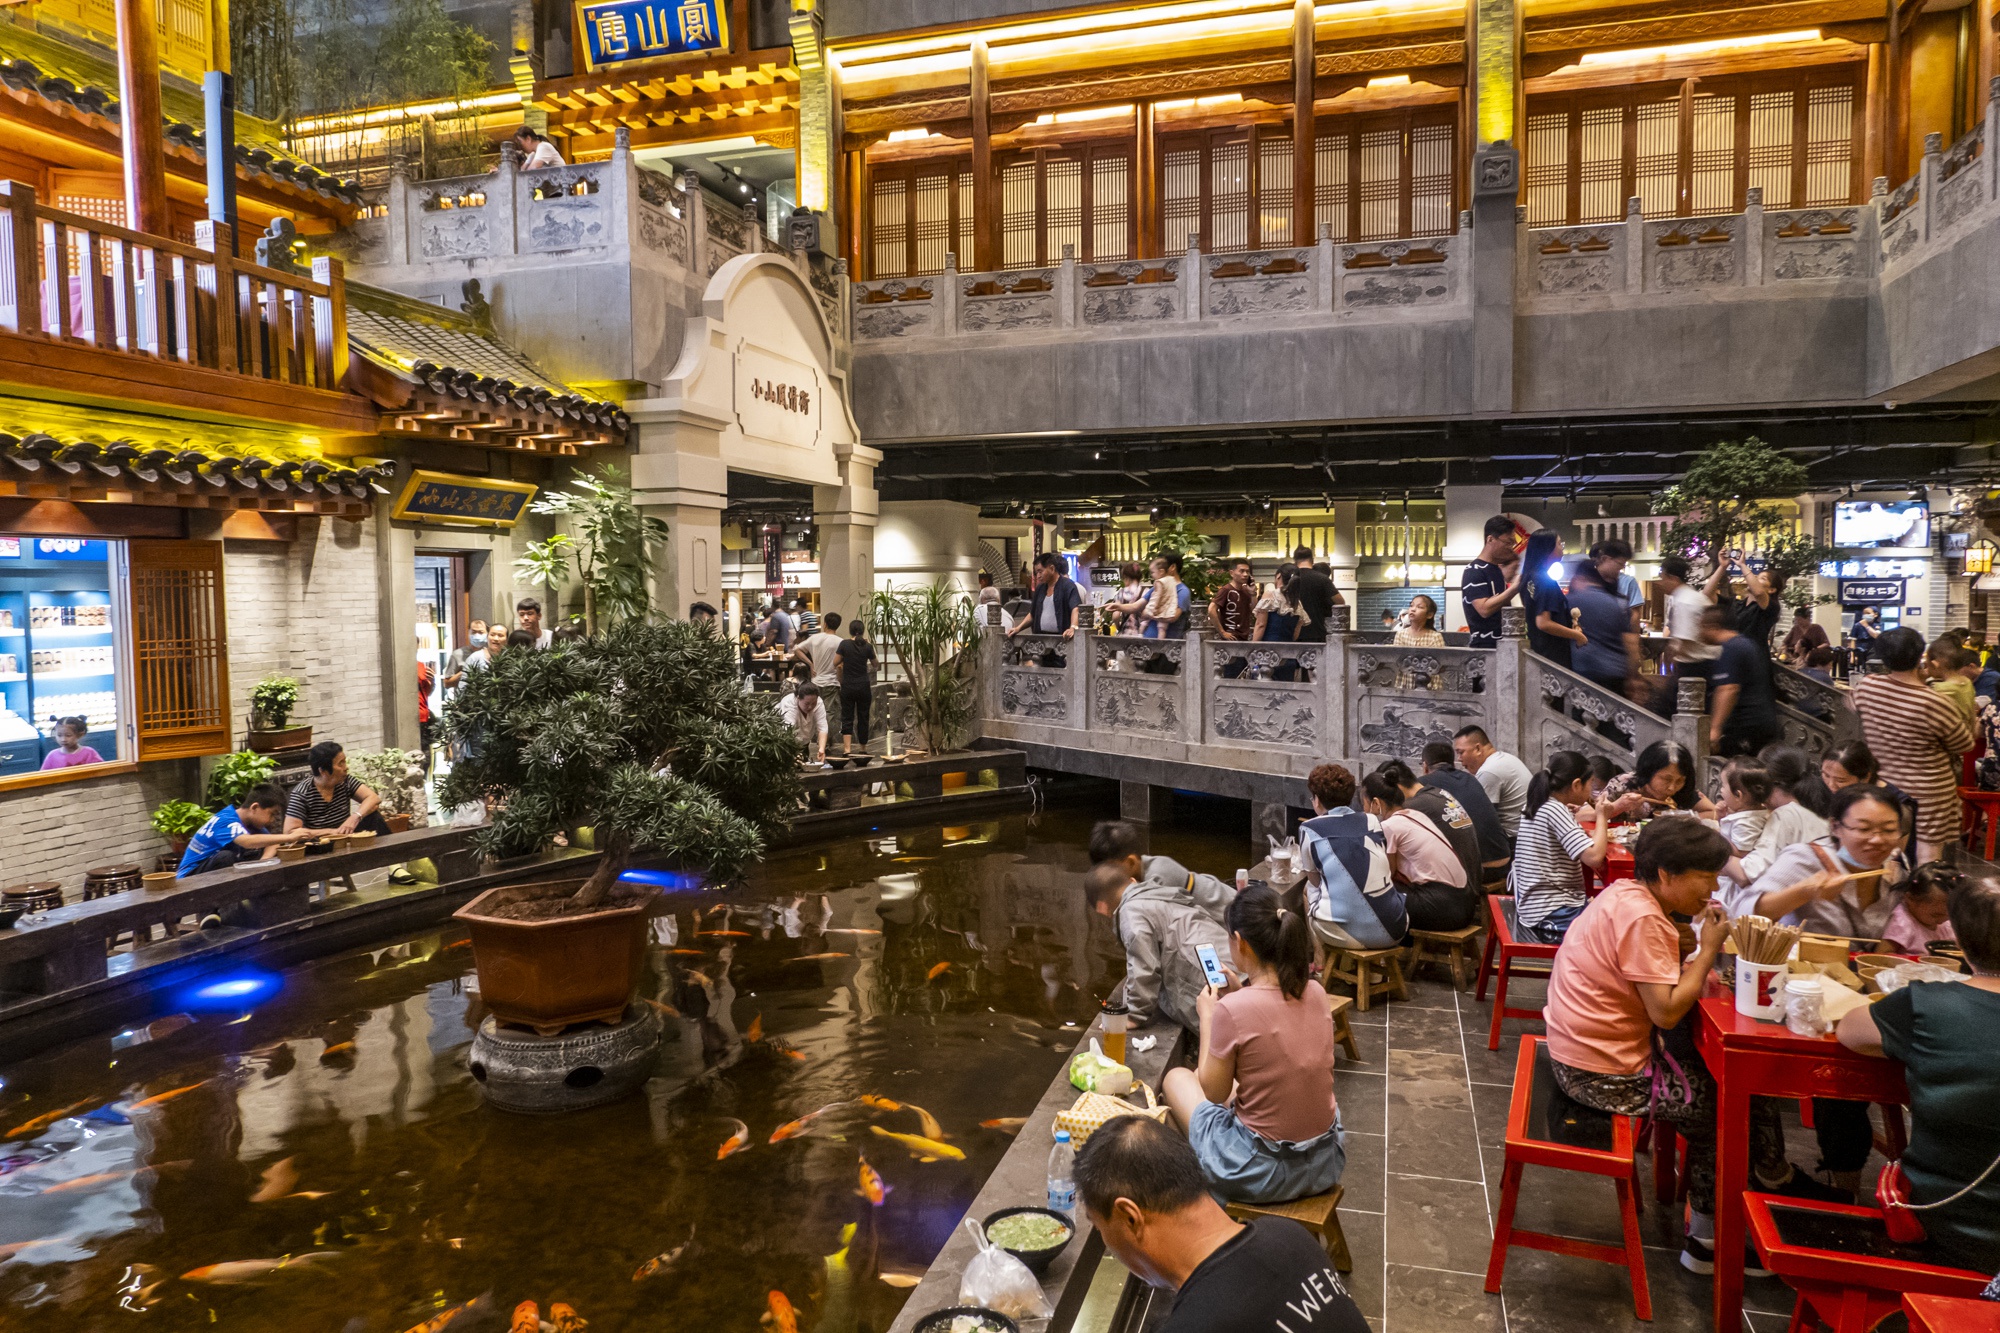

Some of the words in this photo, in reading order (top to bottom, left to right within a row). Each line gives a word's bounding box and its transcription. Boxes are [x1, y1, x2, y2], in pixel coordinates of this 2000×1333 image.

[596, 0, 711, 56] 唐山宴
[419, 488, 515, 516] 小山大世界
